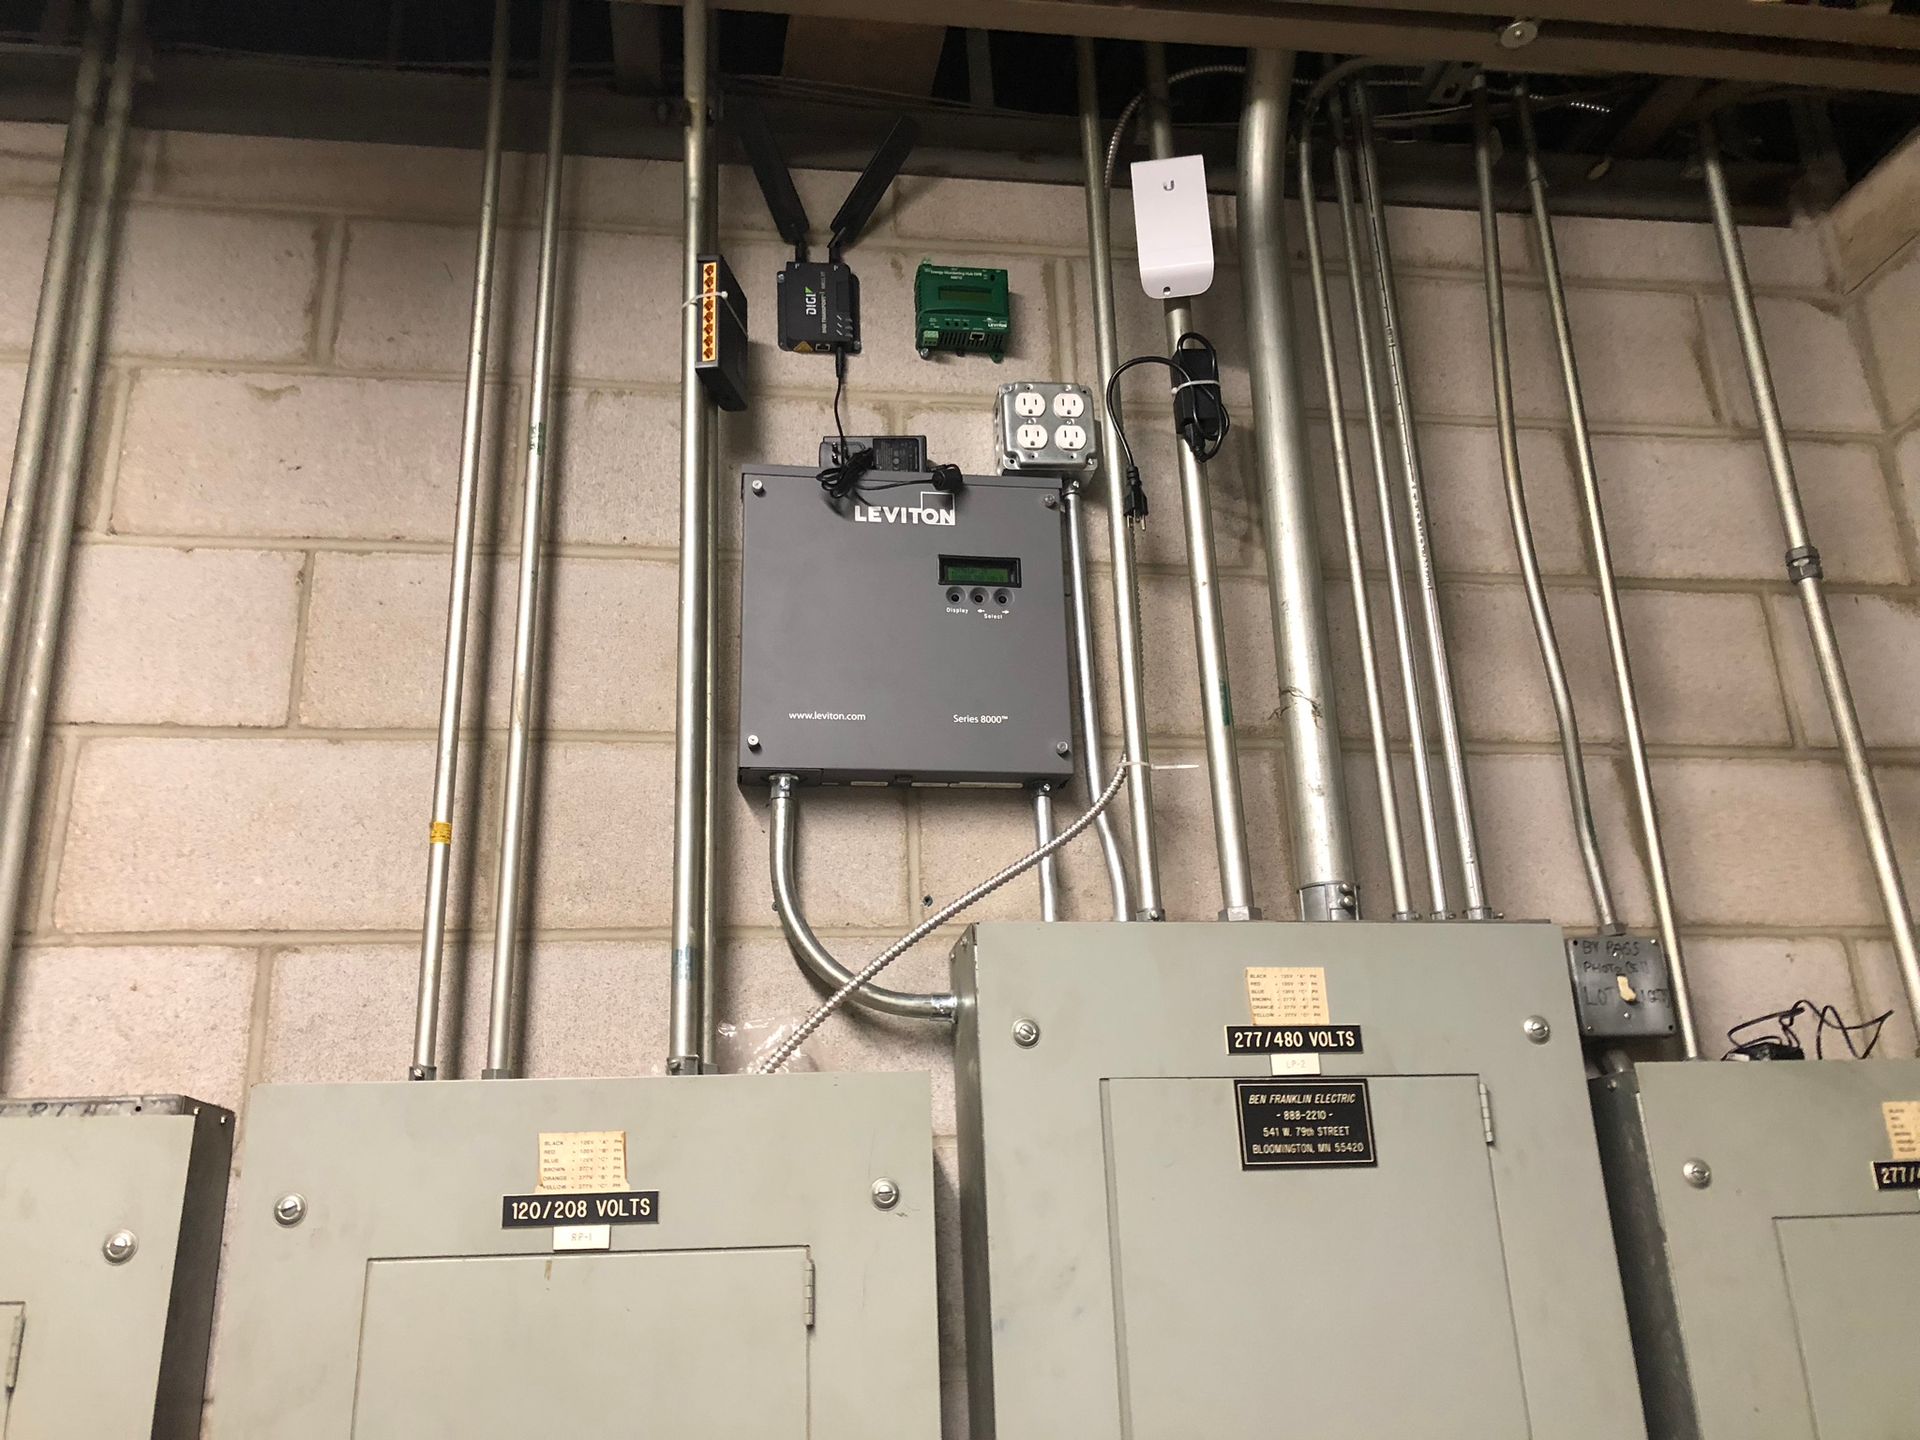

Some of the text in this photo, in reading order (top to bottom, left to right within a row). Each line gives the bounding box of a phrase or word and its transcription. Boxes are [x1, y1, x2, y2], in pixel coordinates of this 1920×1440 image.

[805, 294, 817, 315] DIGI
[854, 505, 956, 526] LEVITON
[788, 711, 866, 721] www.leviton.com
[953, 714, 979, 723] Series
[1583, 941, 1640, 956] BY PASS
[1234, 1030, 1355, 1048] 277/480 VOLTS
[1248, 1094, 1356, 1104] BEN FRANKLIN ELECTRIC
[1262, 1126, 1350, 1137] 541 W. 79th STREET
[1252, 1142, 1364, 1154] BLOOMINGTON, MN 55420
[512, 1198, 651, 1220] 120/208 VOLTS
